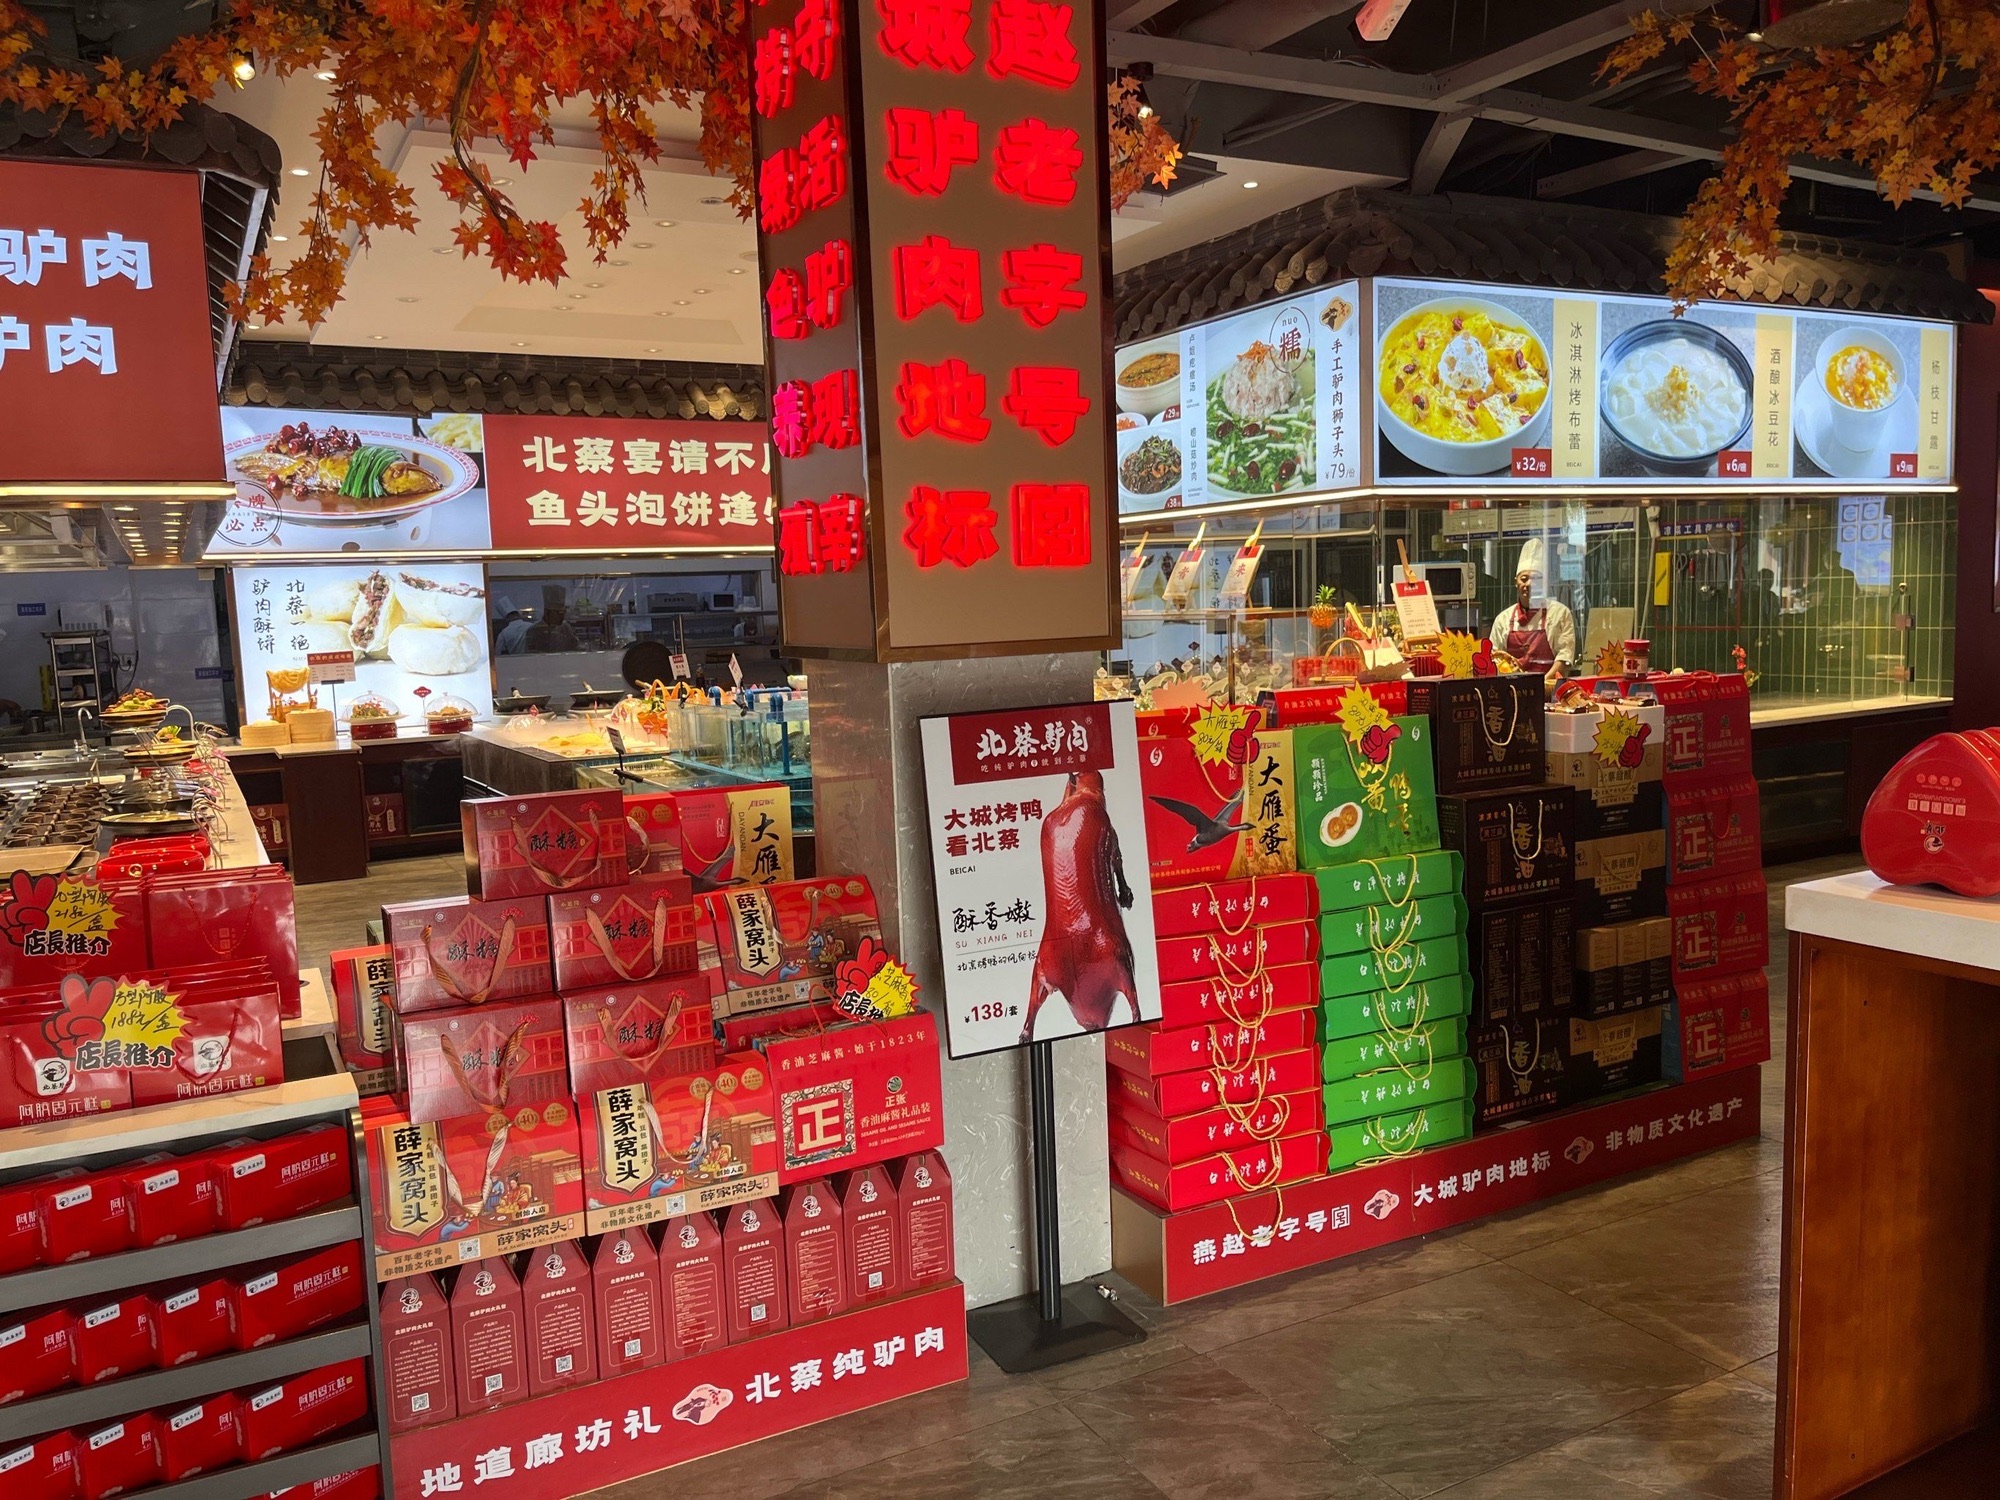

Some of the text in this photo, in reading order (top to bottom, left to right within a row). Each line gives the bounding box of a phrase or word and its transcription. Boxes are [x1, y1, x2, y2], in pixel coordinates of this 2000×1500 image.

[1282, 316, 1298, 327] nuo
[1279, 327, 1302, 362] 糯
[1331, 338, 1345, 459] 手工驴肉狮子头
[1568, 321, 1583, 451] 冰淇淋烤布蕾
[1767, 348, 1781, 448] 酒酿冰豆花
[1516, 455, 1547, 473] ¥32/份
[225, 517, 269, 533] 必点
[251, 578, 276, 654] 驴肉酥饼
[285, 579, 310, 651] 北蔡一绝
[1672, 724, 1697, 762] 正
[944, 798, 1043, 832] 大城烤鸭
[1258, 756, 1288, 857] 大雁蛋
[946, 828, 1020, 858] 看北蔡
[1683, 822, 1707, 862] 正
[949, 865, 976, 876] BEICAI
[735, 893, 770, 969] 薛家窝头
[953, 897, 1036, 934] 酥香嫩
[955, 929, 1034, 949] SU XIANG NEI
[1685, 924, 1710, 960] 正
[964, 1001, 1019, 1025] ¥138/套
[1694, 1022, 1718, 1059] 正
[719, 1077, 735, 1089] 40
[885, 1092, 907, 1109] 正张
[516, 1112, 537, 1125] 40
[797, 1096, 842, 1152] 正
[860, 1101, 931, 1129] 香油麻酱礼品装
[606, 1088, 640, 1185] 薛家窝头
[393, 1128, 430, 1228] 薛家窝头
[700, 1179, 763, 1203] 薛家窝头
[1192, 1209, 1330, 1266] 燕赵老字号
[1413, 1148, 1552, 1208] 大城驴肉地标
[1605, 1096, 1744, 1151] 非物质文化遗产
[609, 1202, 653, 1218] 百年老字号
[496, 1220, 568, 1247] 薛家窝头
[383, 1254, 453, 1277] 非物质文化遗产
[393, 1246, 443, 1266] 百年老字号
[419, 1326, 946, 1498] 地道廊坊礼 北蔡纯驴肉
